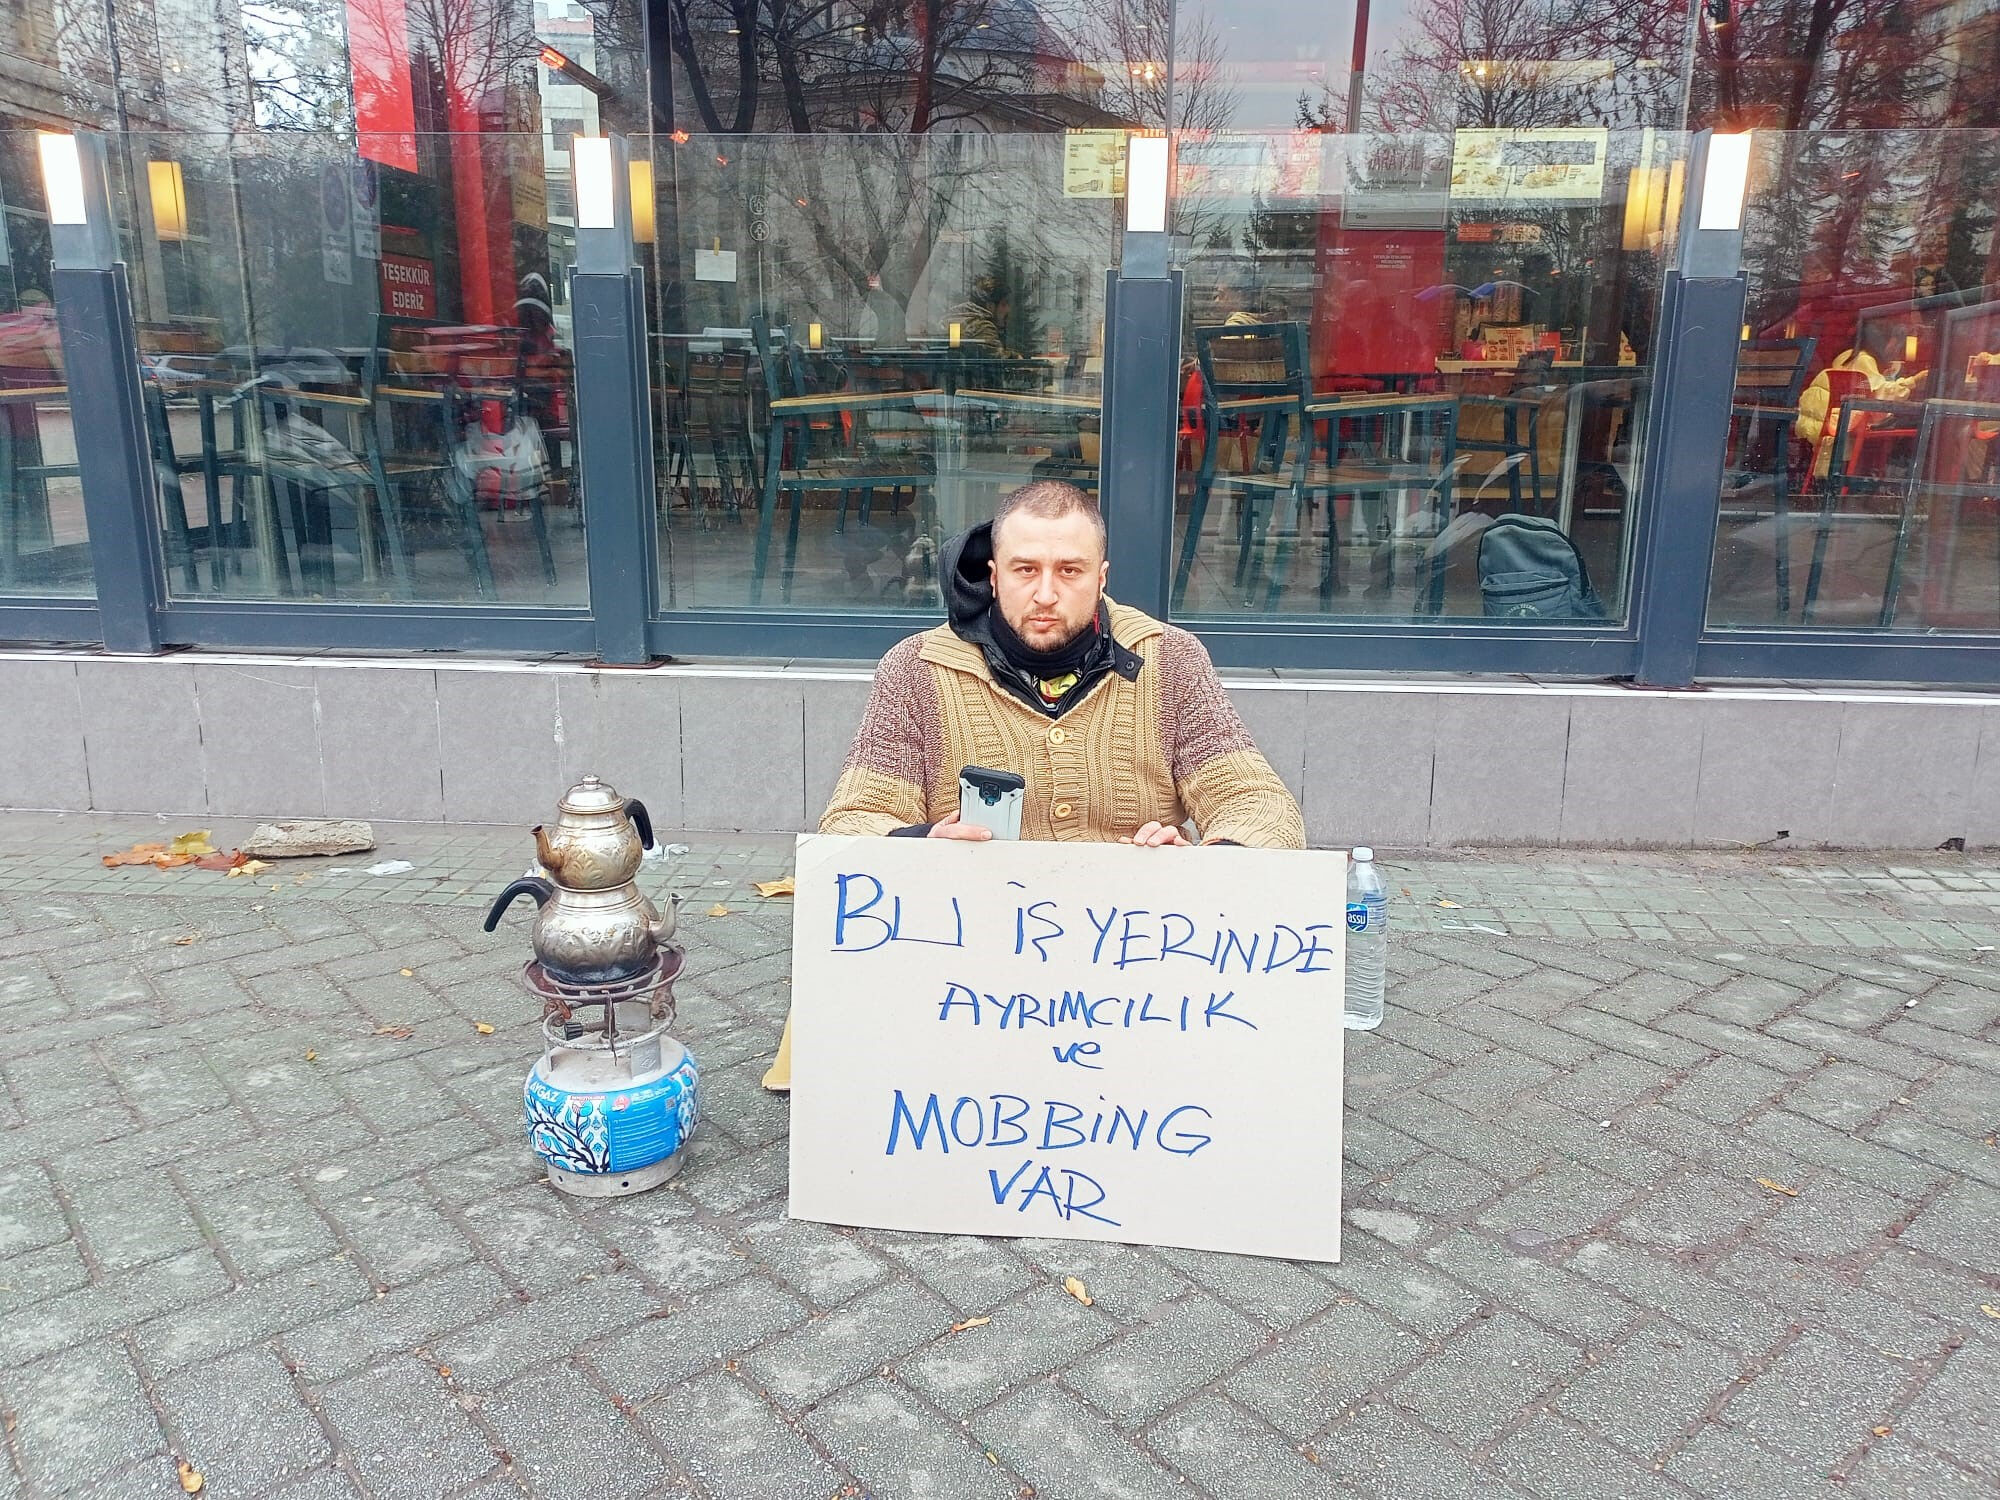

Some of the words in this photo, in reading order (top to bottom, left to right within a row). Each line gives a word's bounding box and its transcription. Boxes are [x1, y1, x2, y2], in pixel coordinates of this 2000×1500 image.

[382, 263, 430, 286] TEŞEKKÜR
[392, 289, 424, 310] EDERİZ
[1347, 912, 1366, 925] assu
[1087, 907, 1333, 974] YERİNDE
[938, 982, 1257, 1031] AYRIMCILIK
[1053, 1041, 1103, 1070] ve
[529, 1080, 559, 1103] AYGAZ
[886, 1089, 1213, 1156] MOBBİNG
[989, 1160, 1121, 1226] VAR
